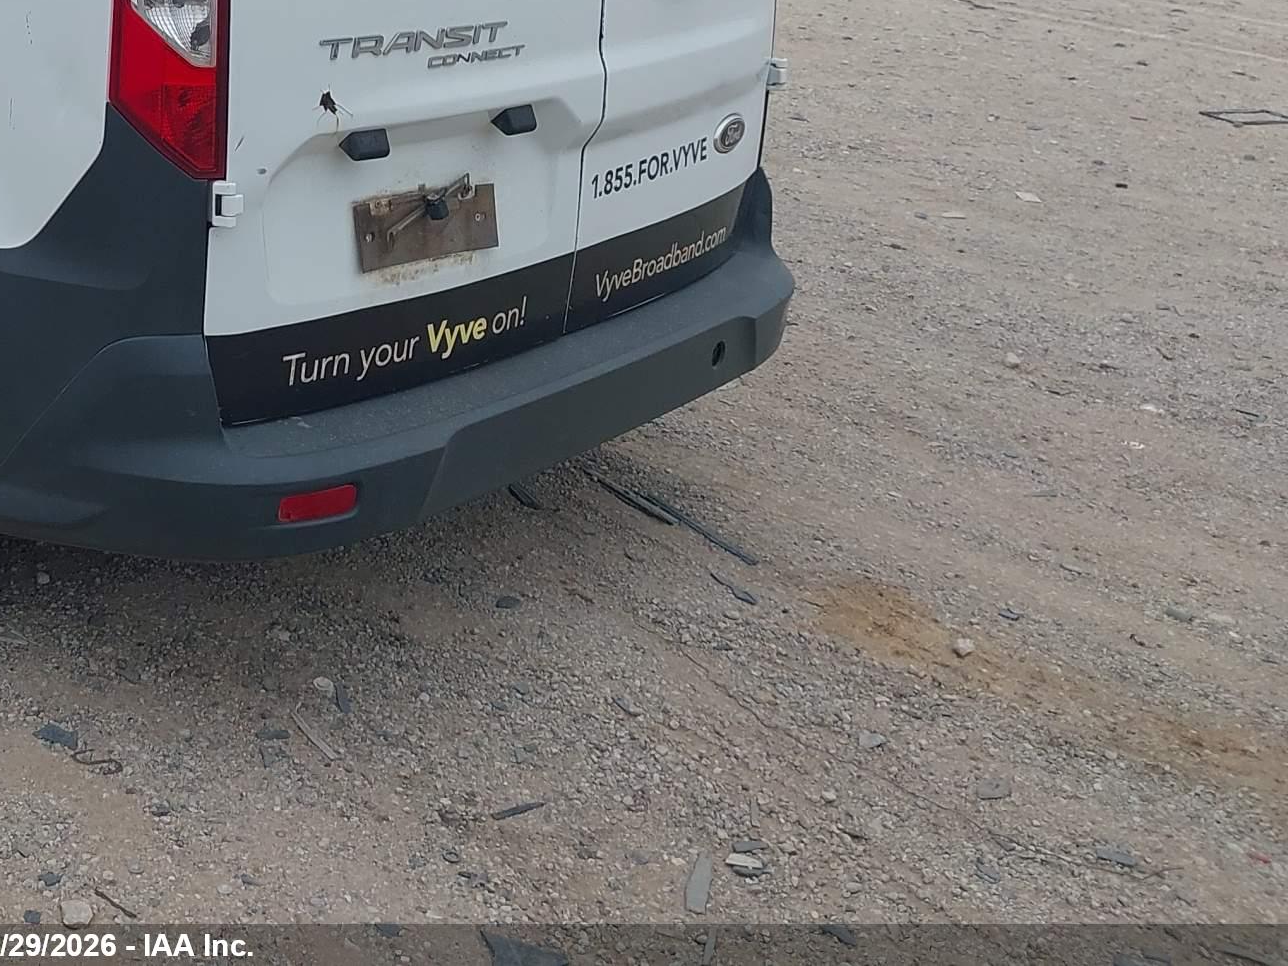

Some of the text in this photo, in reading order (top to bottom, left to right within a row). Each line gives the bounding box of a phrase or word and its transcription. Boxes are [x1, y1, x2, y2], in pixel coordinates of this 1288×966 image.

[319, 21, 508, 61] TRANSIT
[426, 44, 525, 69] CONNECT
[591, 137, 707, 199] 1.855.FOR.VYVE
[595, 226, 727, 302] VyveBroadband.com
[282, 295, 528, 386] Turn your Vyve on!
